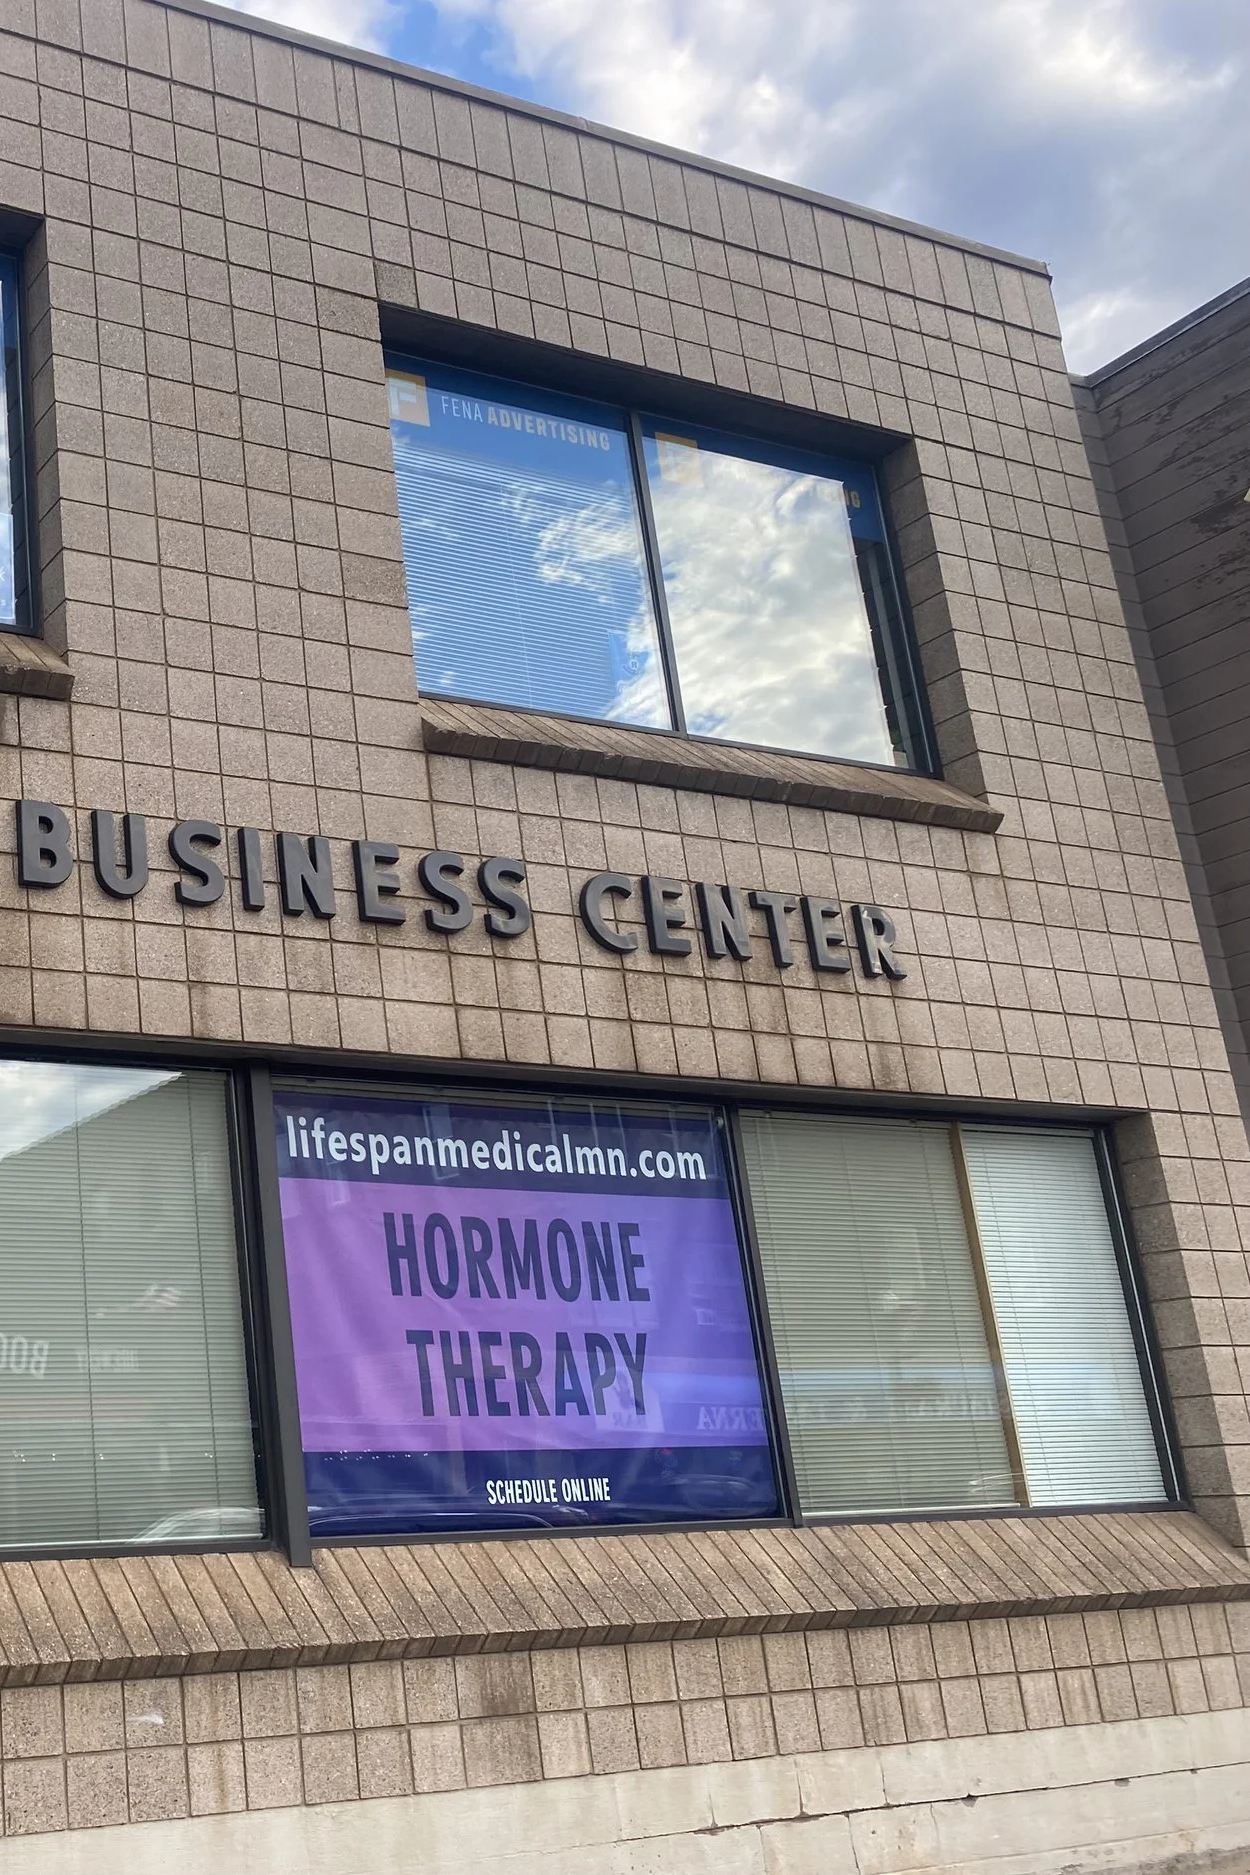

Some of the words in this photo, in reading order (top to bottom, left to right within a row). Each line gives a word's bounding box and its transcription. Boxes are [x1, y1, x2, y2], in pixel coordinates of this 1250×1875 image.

[441, 396, 483, 423] FENA
[487, 407, 611, 451] ADVERTISING
[15, 799, 532, 938] BUSINESS
[579, 872, 908, 980] CENTER
[285, 1115, 707, 1180] lifespanmedicalmn.com
[382, 1211, 652, 1301] HORMONE
[406, 1329, 649, 1417] THERAPY
[486, 1478, 558, 1505] SCHEDULE
[561, 1477, 611, 1502] ONLINE
